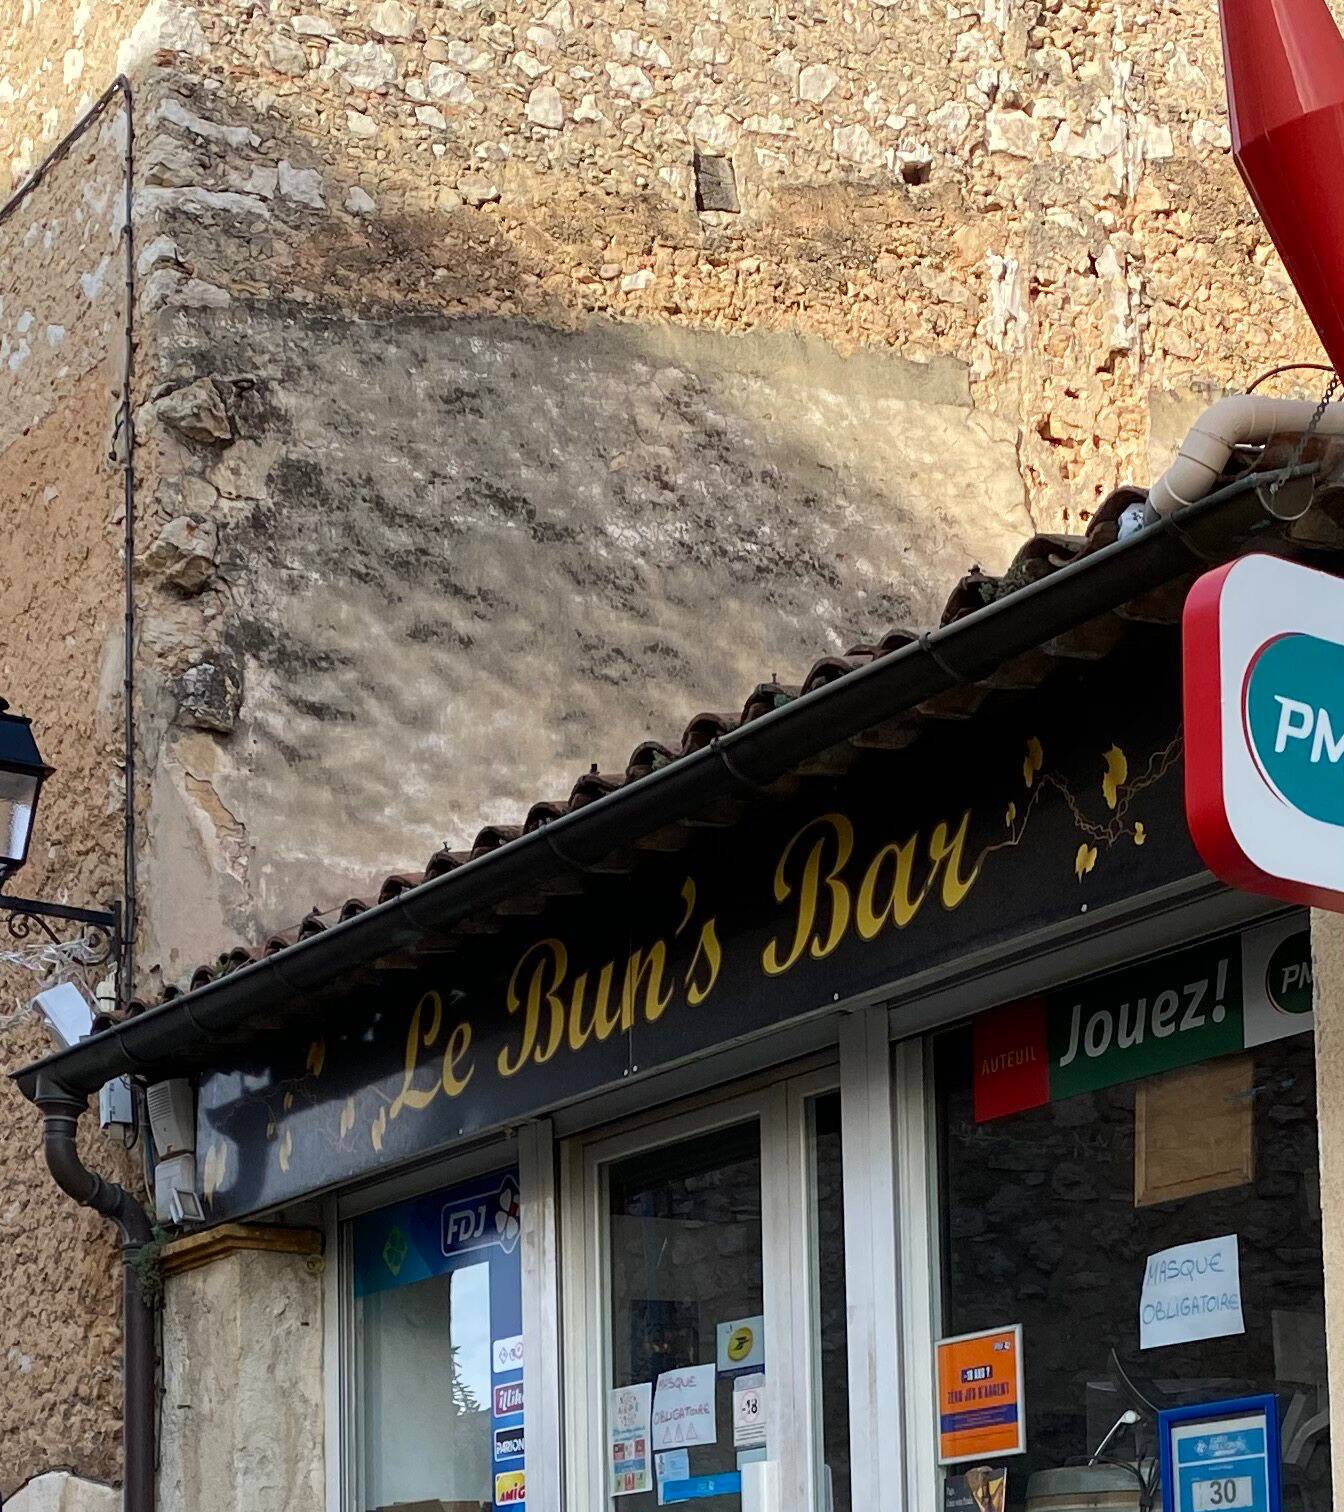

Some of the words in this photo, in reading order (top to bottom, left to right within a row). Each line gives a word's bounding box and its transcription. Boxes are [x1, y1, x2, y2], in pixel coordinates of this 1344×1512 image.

[389, 989, 475, 1119] Le
[496, 876, 722, 1077] Bun's
[763, 809, 975, 977] Bar
[1058, 957, 1229, 1068] Jouez!
[981, 1047, 1037, 1077] AUTEUIL
[446, 1205, 487, 1245] FDJ
[1147, 1253, 1224, 1286] MASQUE
[1142, 1293, 1239, 1325] OBLIGATOIRE
[499, 1388, 523, 1411] illik
[496, 1439, 524, 1455] PARION
[499, 1482, 525, 1502] AMIG
[1209, 1479, 1237, 1505] 30
